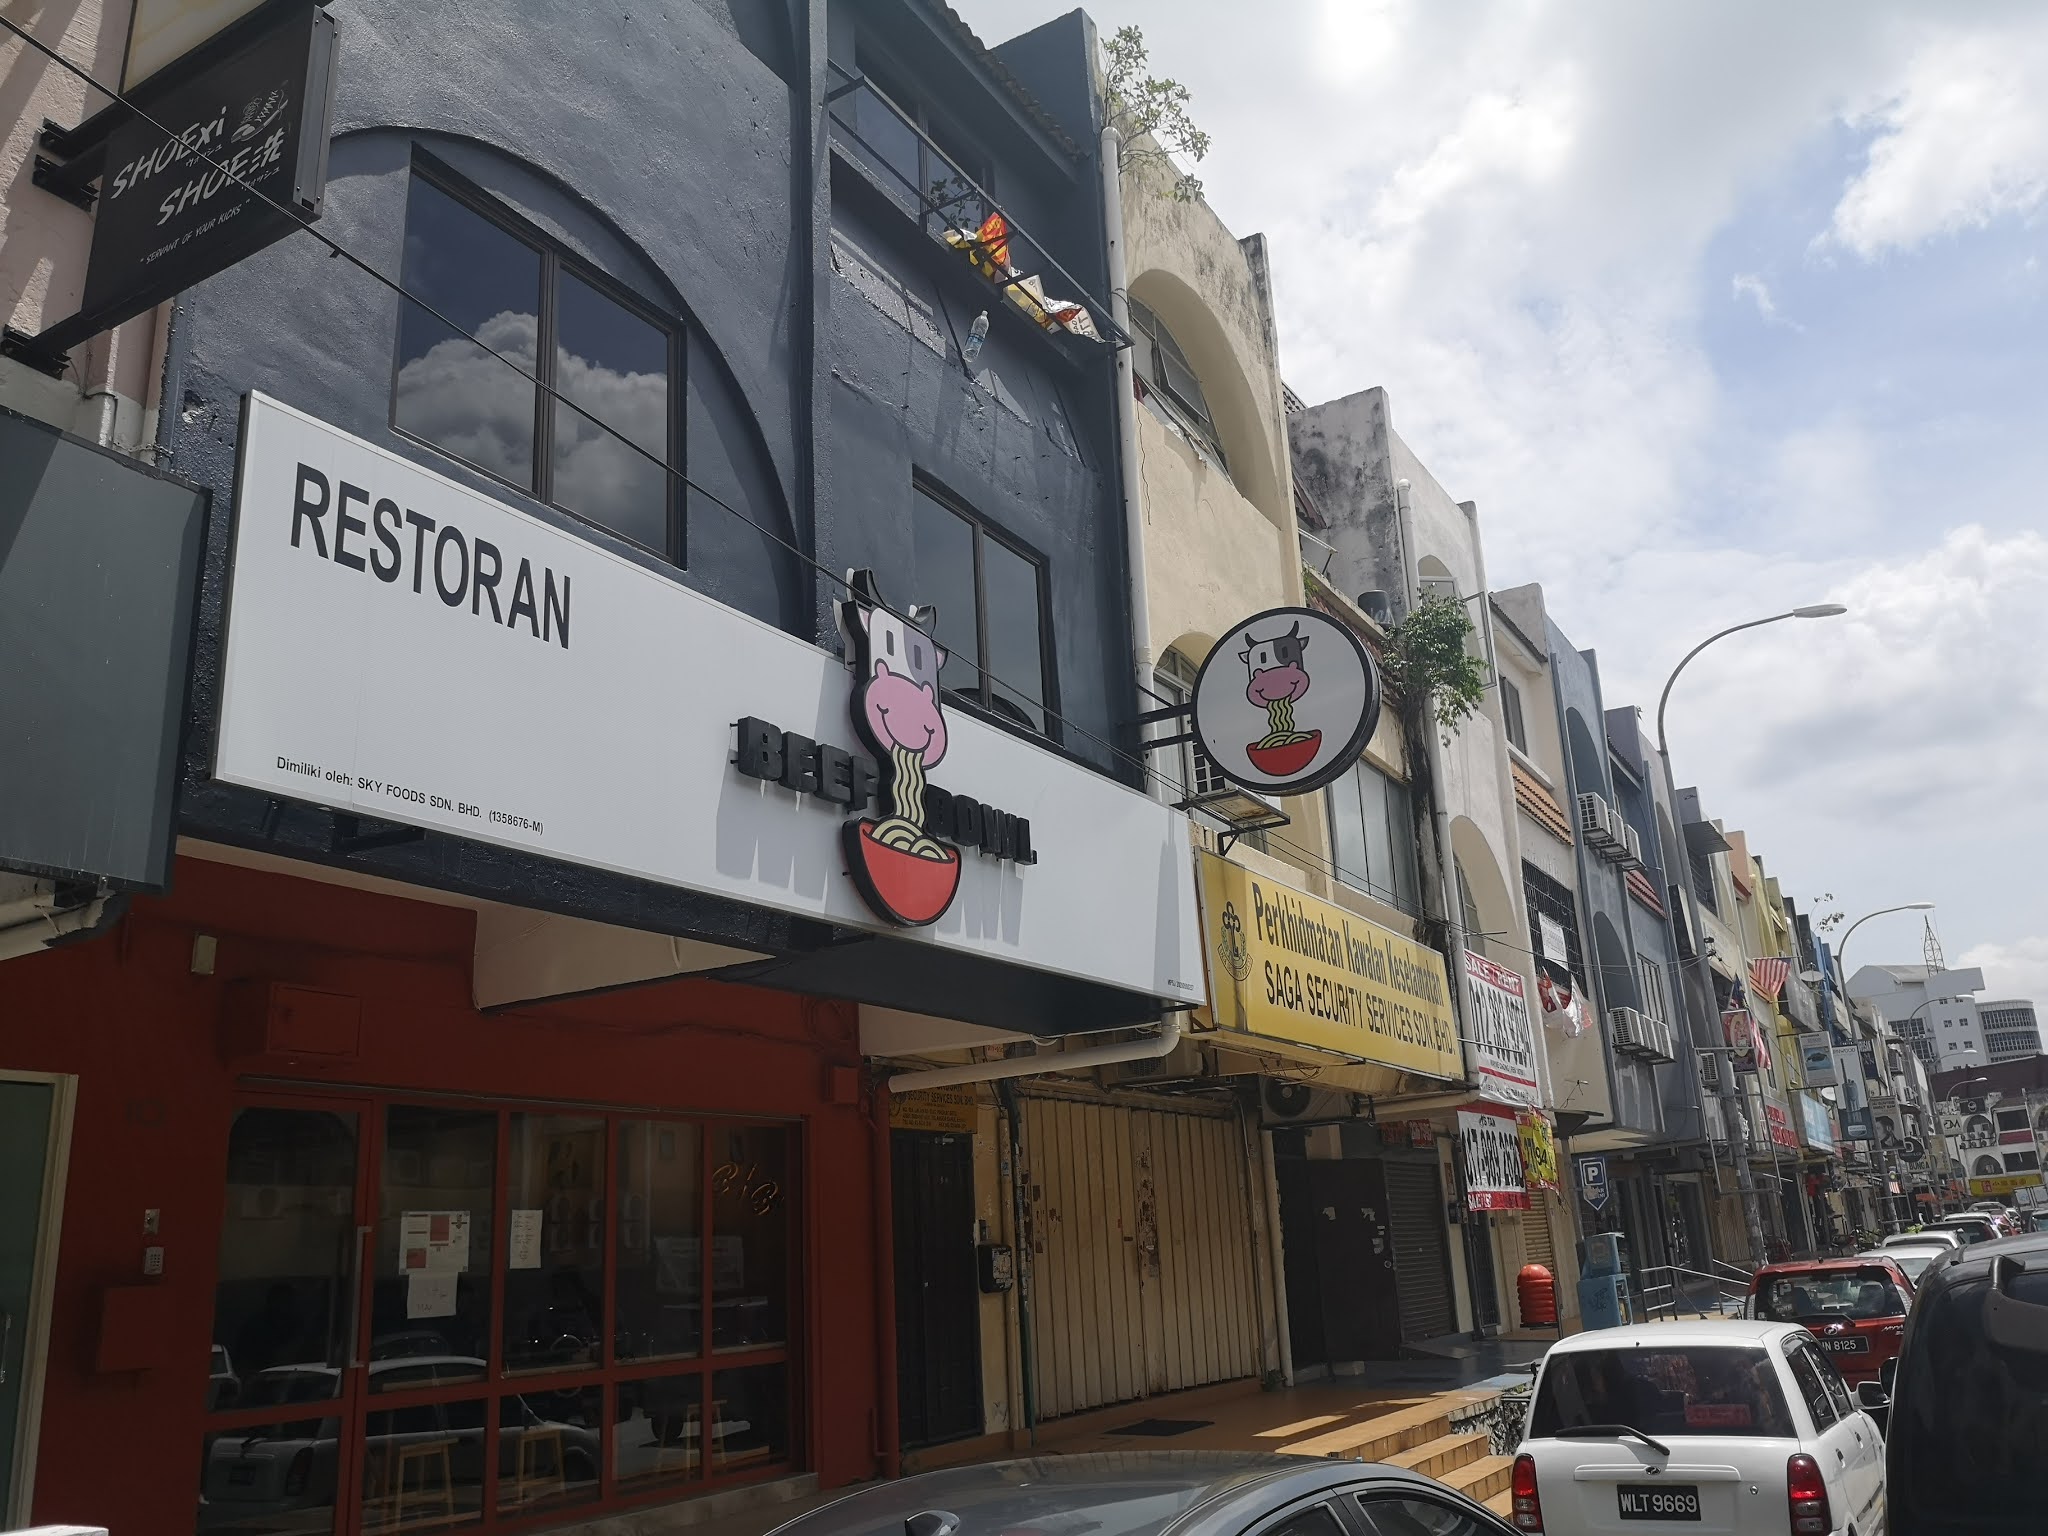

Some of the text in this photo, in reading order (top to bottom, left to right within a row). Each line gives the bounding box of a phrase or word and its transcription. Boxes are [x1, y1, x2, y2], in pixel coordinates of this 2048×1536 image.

[181, 230, 194, 245] OF
[195, 218, 217, 237] YOUR
[290, 461, 571, 650] RESTORAN
[276, 755, 544, 836] Dimiliki oleh: SKY FOODS SDN. BHD. (1358676-M)
[1251, 881, 1345, 969] Perkhidmatan
[1342, 918, 1387, 985] Kawalan
[1385, 938, 1445, 1008] Keselamatan
[1465, 954, 1490, 980] SALE
[1265, 960, 1305, 1012] SAGA
[1306, 972, 1363, 1029] SECURITY
[1366, 992, 1414, 1044] SERVICES
[1413, 1007, 1436, 1051] SDN.
[1433, 1016, 1456, 1056] BHD.
[1587, 1167, 1599, 1182] P
[1833, 1340, 1857, 1351] 8125
[1620, 1491, 1697, 1514] WLT 9669
